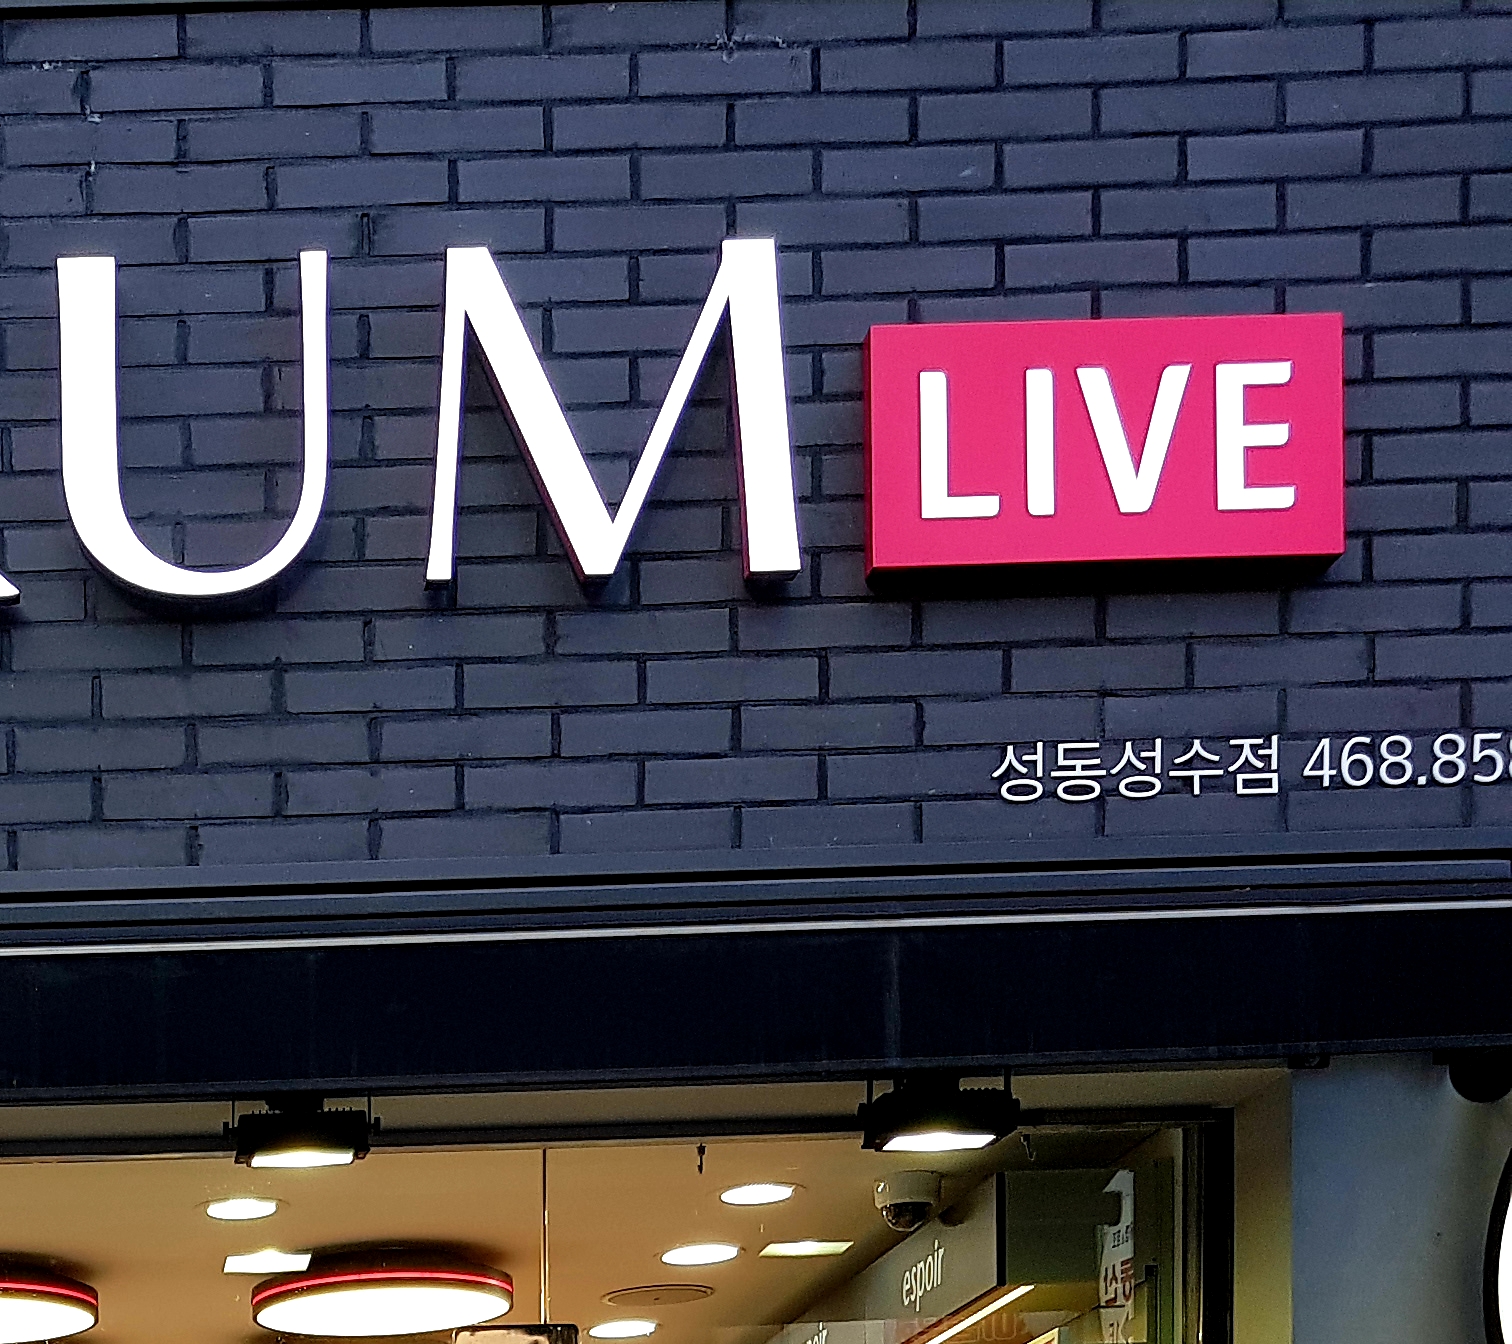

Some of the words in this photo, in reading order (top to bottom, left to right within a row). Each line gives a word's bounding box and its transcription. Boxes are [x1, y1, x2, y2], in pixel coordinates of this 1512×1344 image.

[919, 361, 1296, 520] LIVE
[991, 735, 1280, 802] 성동성수점
[1303, 732, 1512, 787] 468.85
[902, 1240, 945, 1313] espoir
